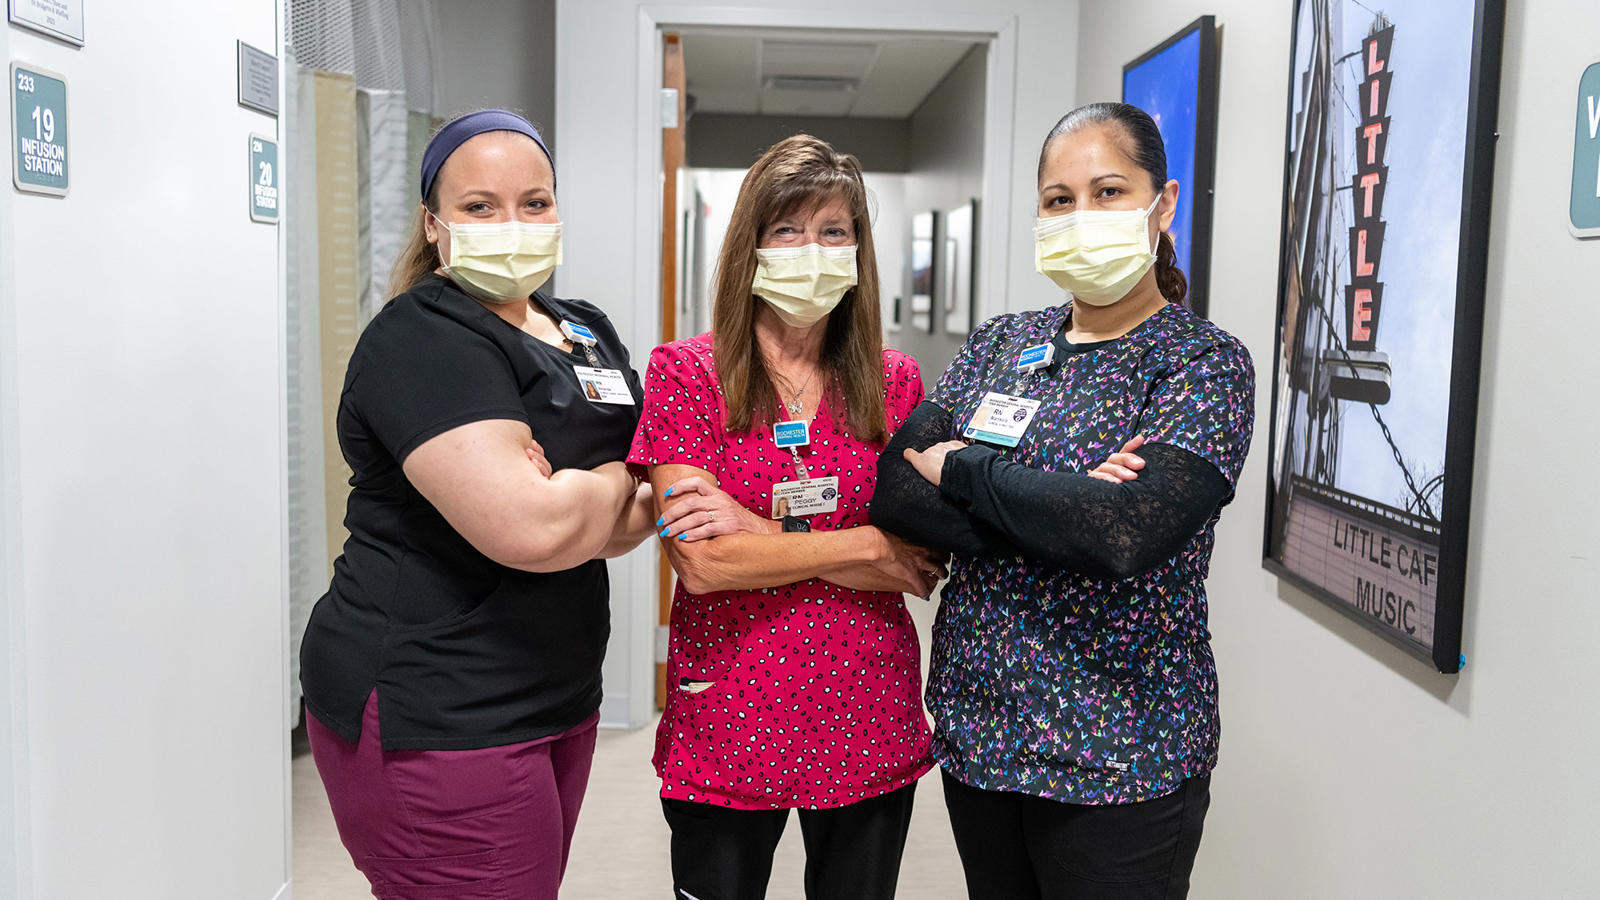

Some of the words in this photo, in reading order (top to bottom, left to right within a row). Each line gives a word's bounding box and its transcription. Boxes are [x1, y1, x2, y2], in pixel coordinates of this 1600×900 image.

[18, 73, 34, 92] 233
[32, 105, 55, 143] 19
[21, 137, 65, 161] INFUSION
[24, 155, 63, 176] STATION
[259, 161, 273, 187] 20
[256, 195, 277, 209] STATION
[1352, 39, 1384, 342] LITTLE
[993, 408, 1003, 416] RN
[1334, 519, 1392, 569] LITTLE
[1356, 577, 1416, 635] MUSIC
